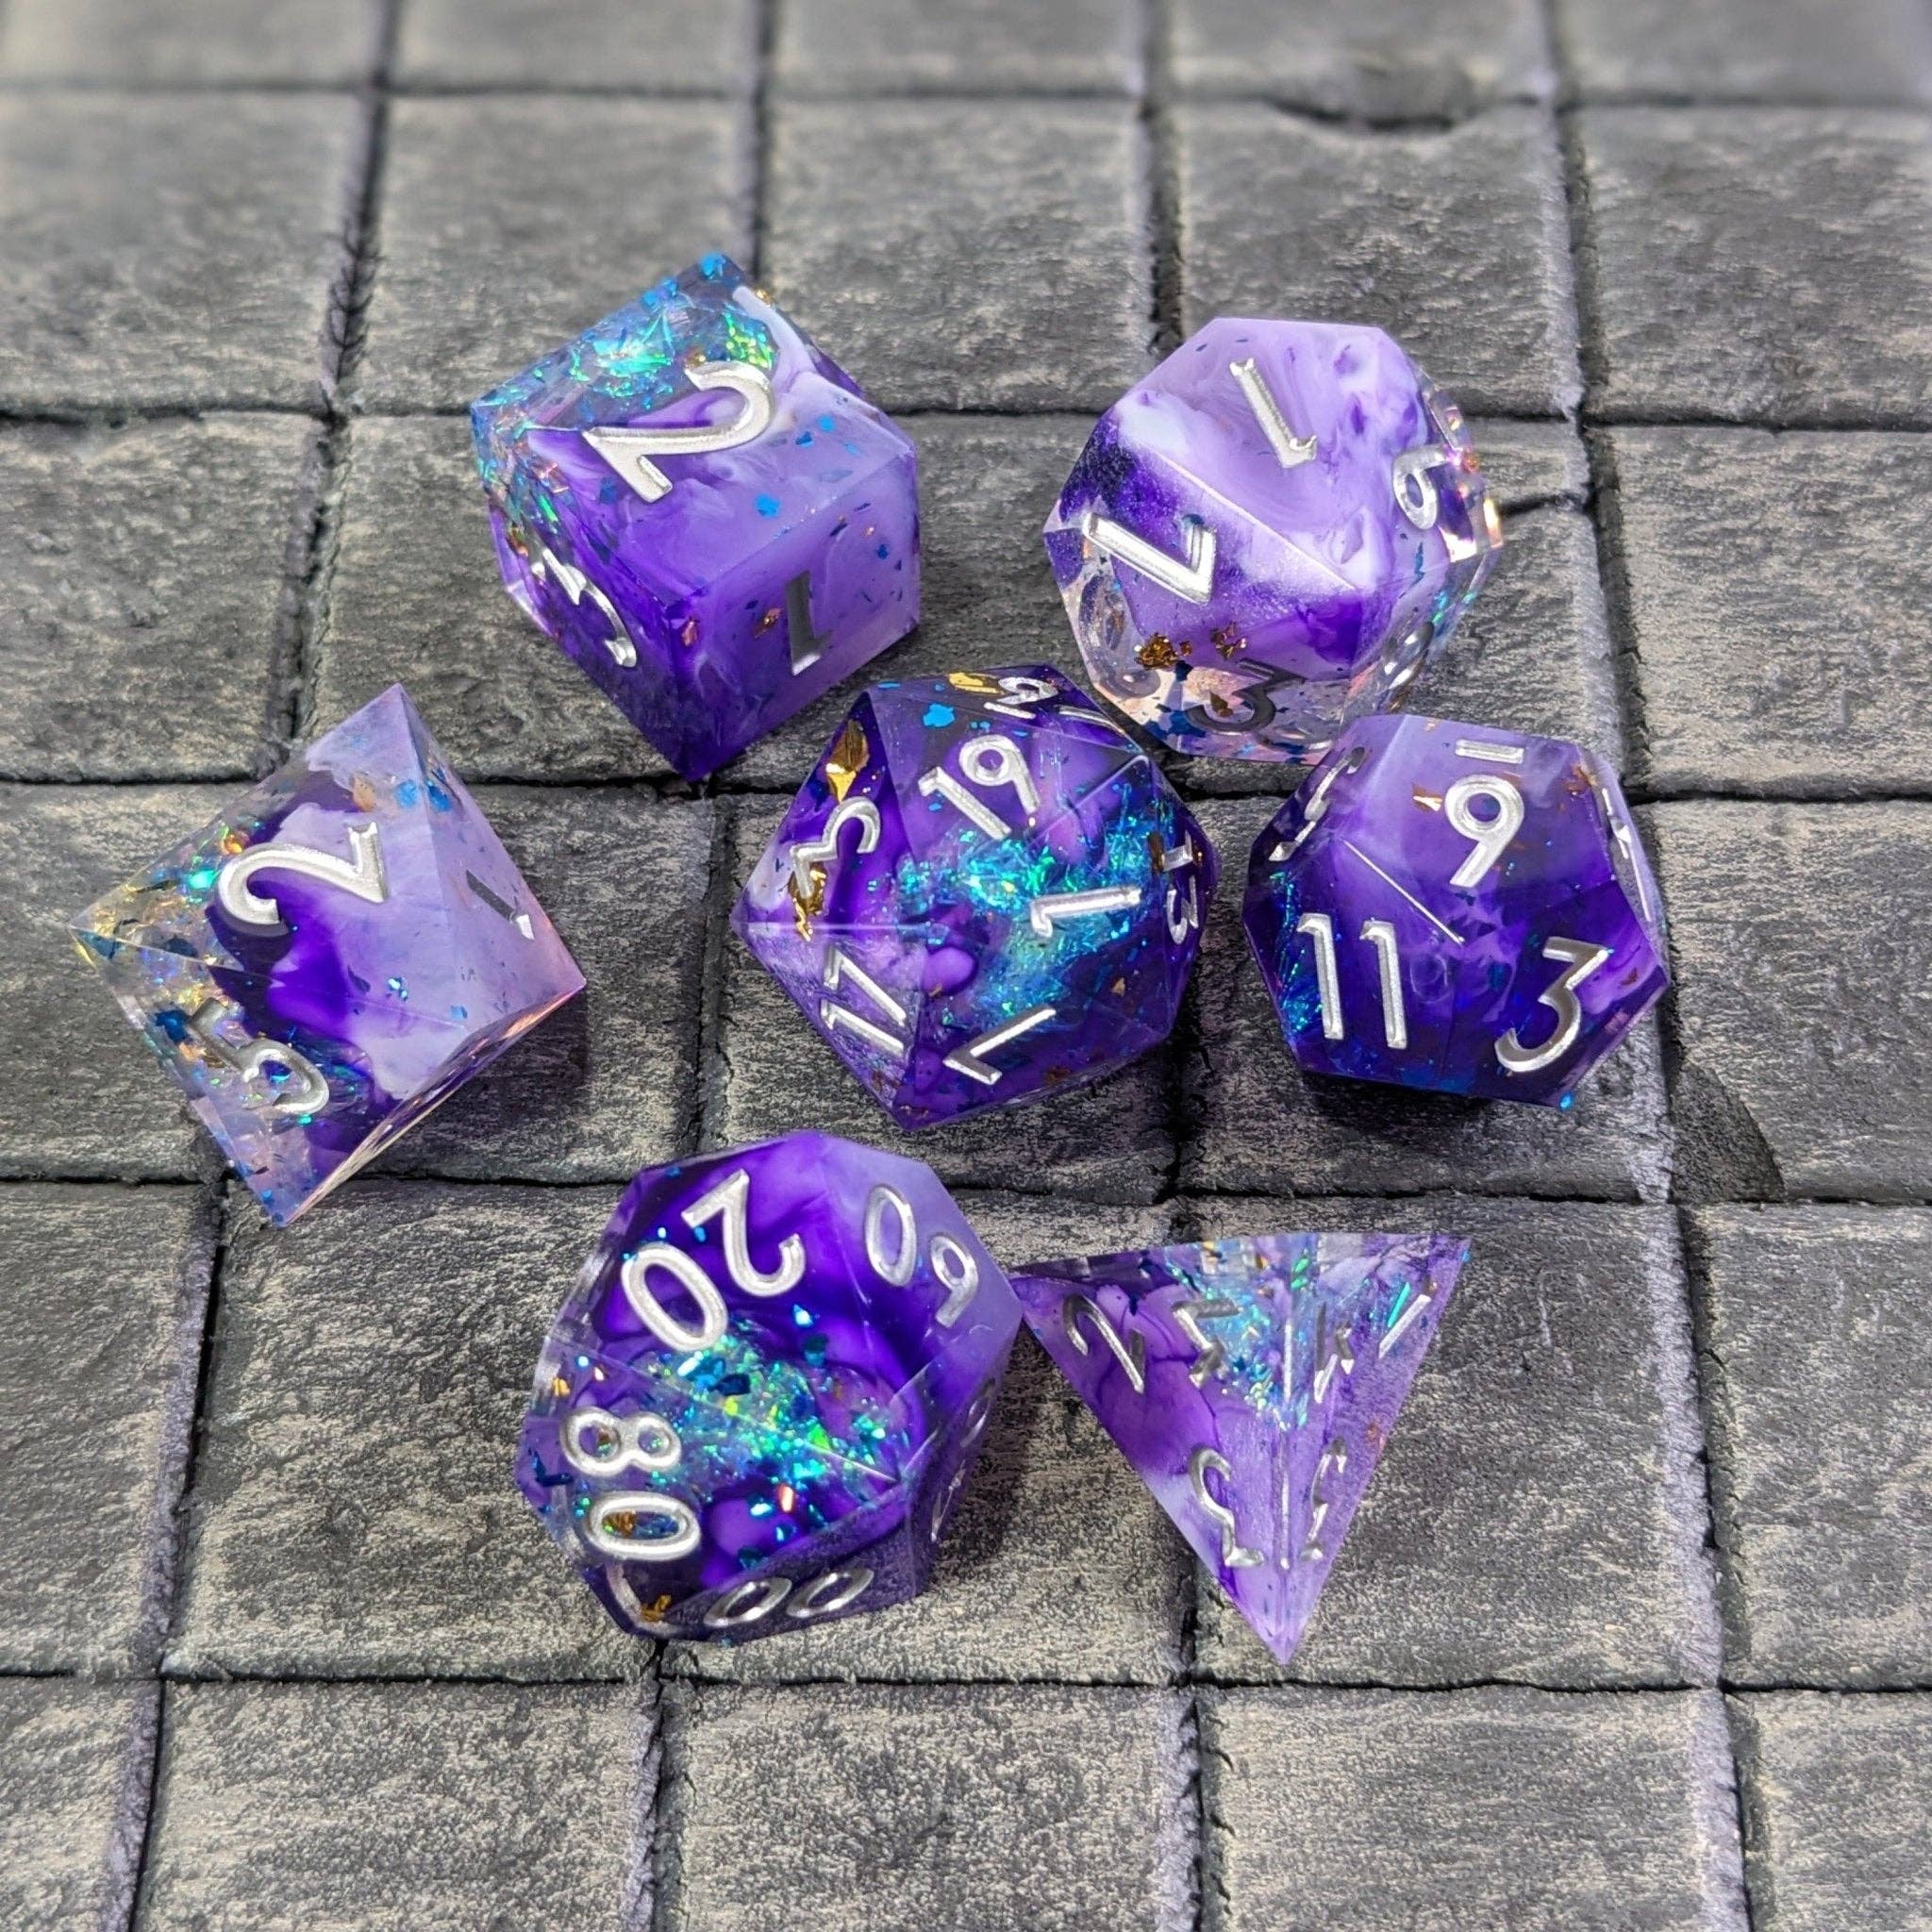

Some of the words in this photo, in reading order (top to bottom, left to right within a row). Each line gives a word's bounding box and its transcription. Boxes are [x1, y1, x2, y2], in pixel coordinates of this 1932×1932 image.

[582, 359, 776, 503] 2
[790, 796, 882, 898] 3
[918, 734, 1040, 841] 19
[215, 822, 389, 924] 2
[1295, 912, 1407, 1050] 11
[1493, 936, 1613, 1074] 3
[620, 1168, 807, 1352] 20
[560, 1406, 702, 1561] 80
